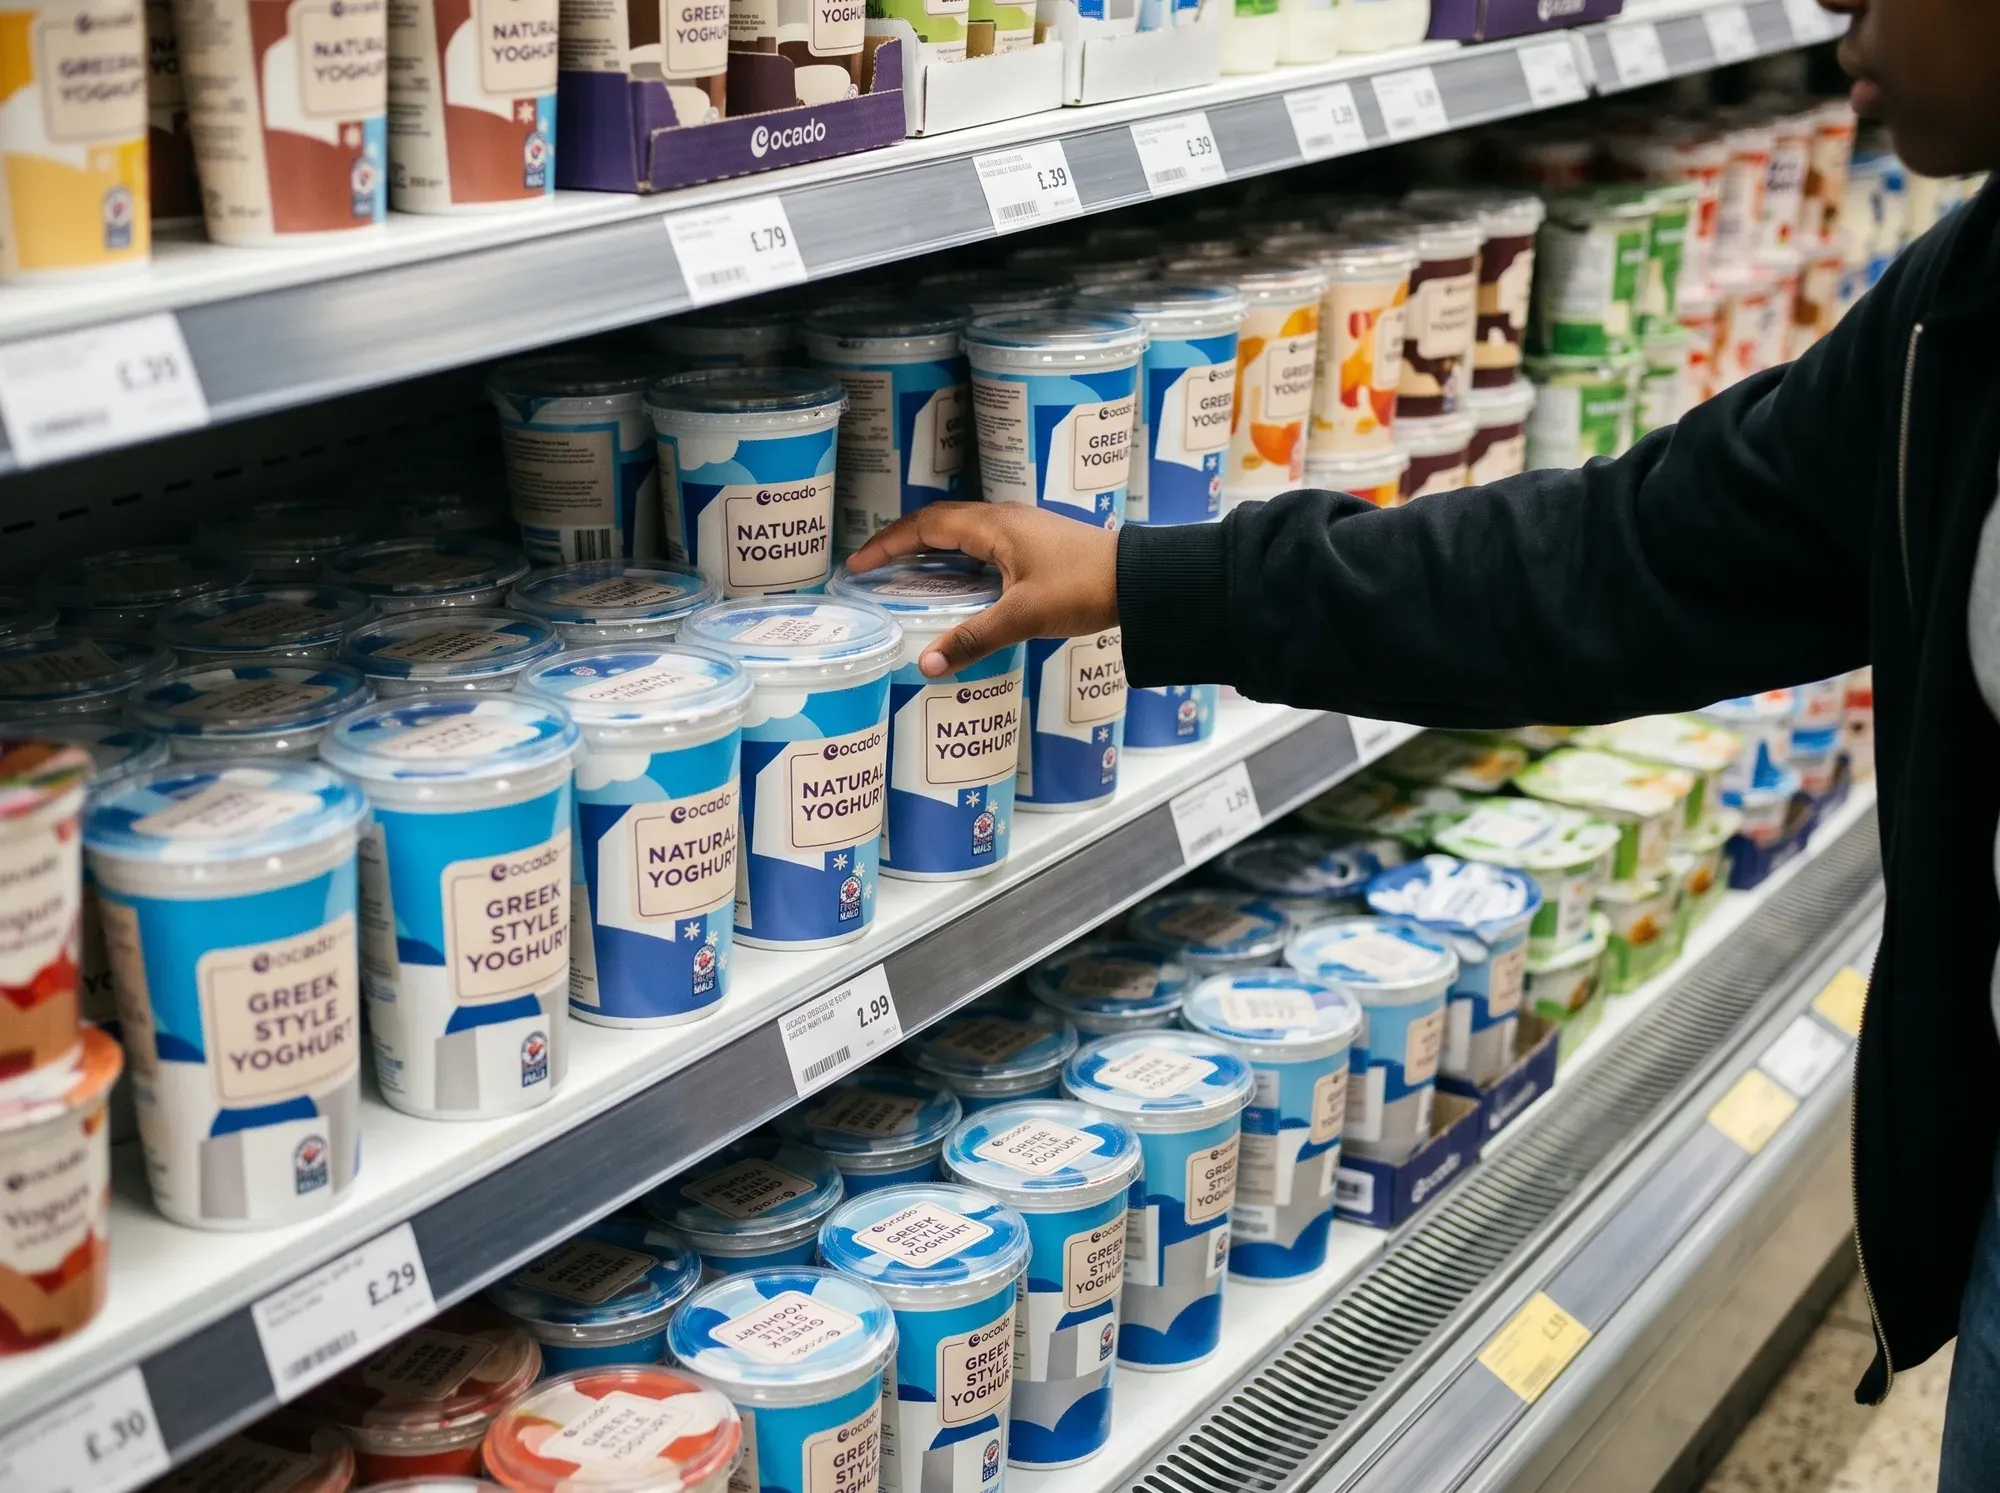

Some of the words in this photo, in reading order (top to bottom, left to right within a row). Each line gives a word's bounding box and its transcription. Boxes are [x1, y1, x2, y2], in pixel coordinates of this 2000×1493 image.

[682, 5, 727, 22] GREEK
[770, 118, 826, 151] ocado
[1187, 136, 1213, 157] £.39
[1037, 167, 1068, 190] £.39
[751, 226, 786, 252] £.79
[772, 486, 816, 504] ocado
[738, 515, 826, 540] NATURAL
[736, 535, 827, 562] YOGHURT
[1080, 660, 1124, 682] NATU
[973, 681, 1013, 701] ocado
[1077, 677, 1127, 700] YOGHU
[937, 709, 1017, 738] NATURAL
[840, 733, 880, 757] ocado
[936, 730, 1017, 759] YOGHURT
[803, 762, 884, 799] NATURAL
[689, 793, 731, 819] ocado
[802, 784, 884, 821] YOGHURT
[649, 823, 736, 864] NATURAL
[510, 849, 559, 878] ocado
[648, 845, 736, 888] YOGHURT
[486, 879, 562, 919] GREEK
[491, 906, 559, 945] STYLE
[467, 925, 568, 972] YOGHURT
[249, 970, 339, 1015] GREEK
[255, 1000, 339, 1042] STYLE
[857, 995, 889, 1028] 2.99
[229, 1017, 352, 1073] YOGHURT
[1027, 1136, 1083, 1167] YOGHURT
[884, 1208, 917, 1228] ocado
[887, 1216, 938, 1244] GREEK
[901, 1222, 949, 1248] STYLE
[905, 1223, 971, 1257] YOGHURT
[367, 1263, 416, 1305] £.29
[575, 1256, 635, 1293] YOGHURT
[735, 1303, 808, 1341] YOGHURT
[757, 1314, 808, 1341] STYLE
[772, 1318, 824, 1349] GREEK
[982, 1316, 1010, 1343] ocado
[965, 1335, 1010, 1370] GREEK
[967, 1352, 1009, 1387] STYLE
[833, 1426, 879, 1468] GREEK
[836, 1446, 877, 1484] STYLE
